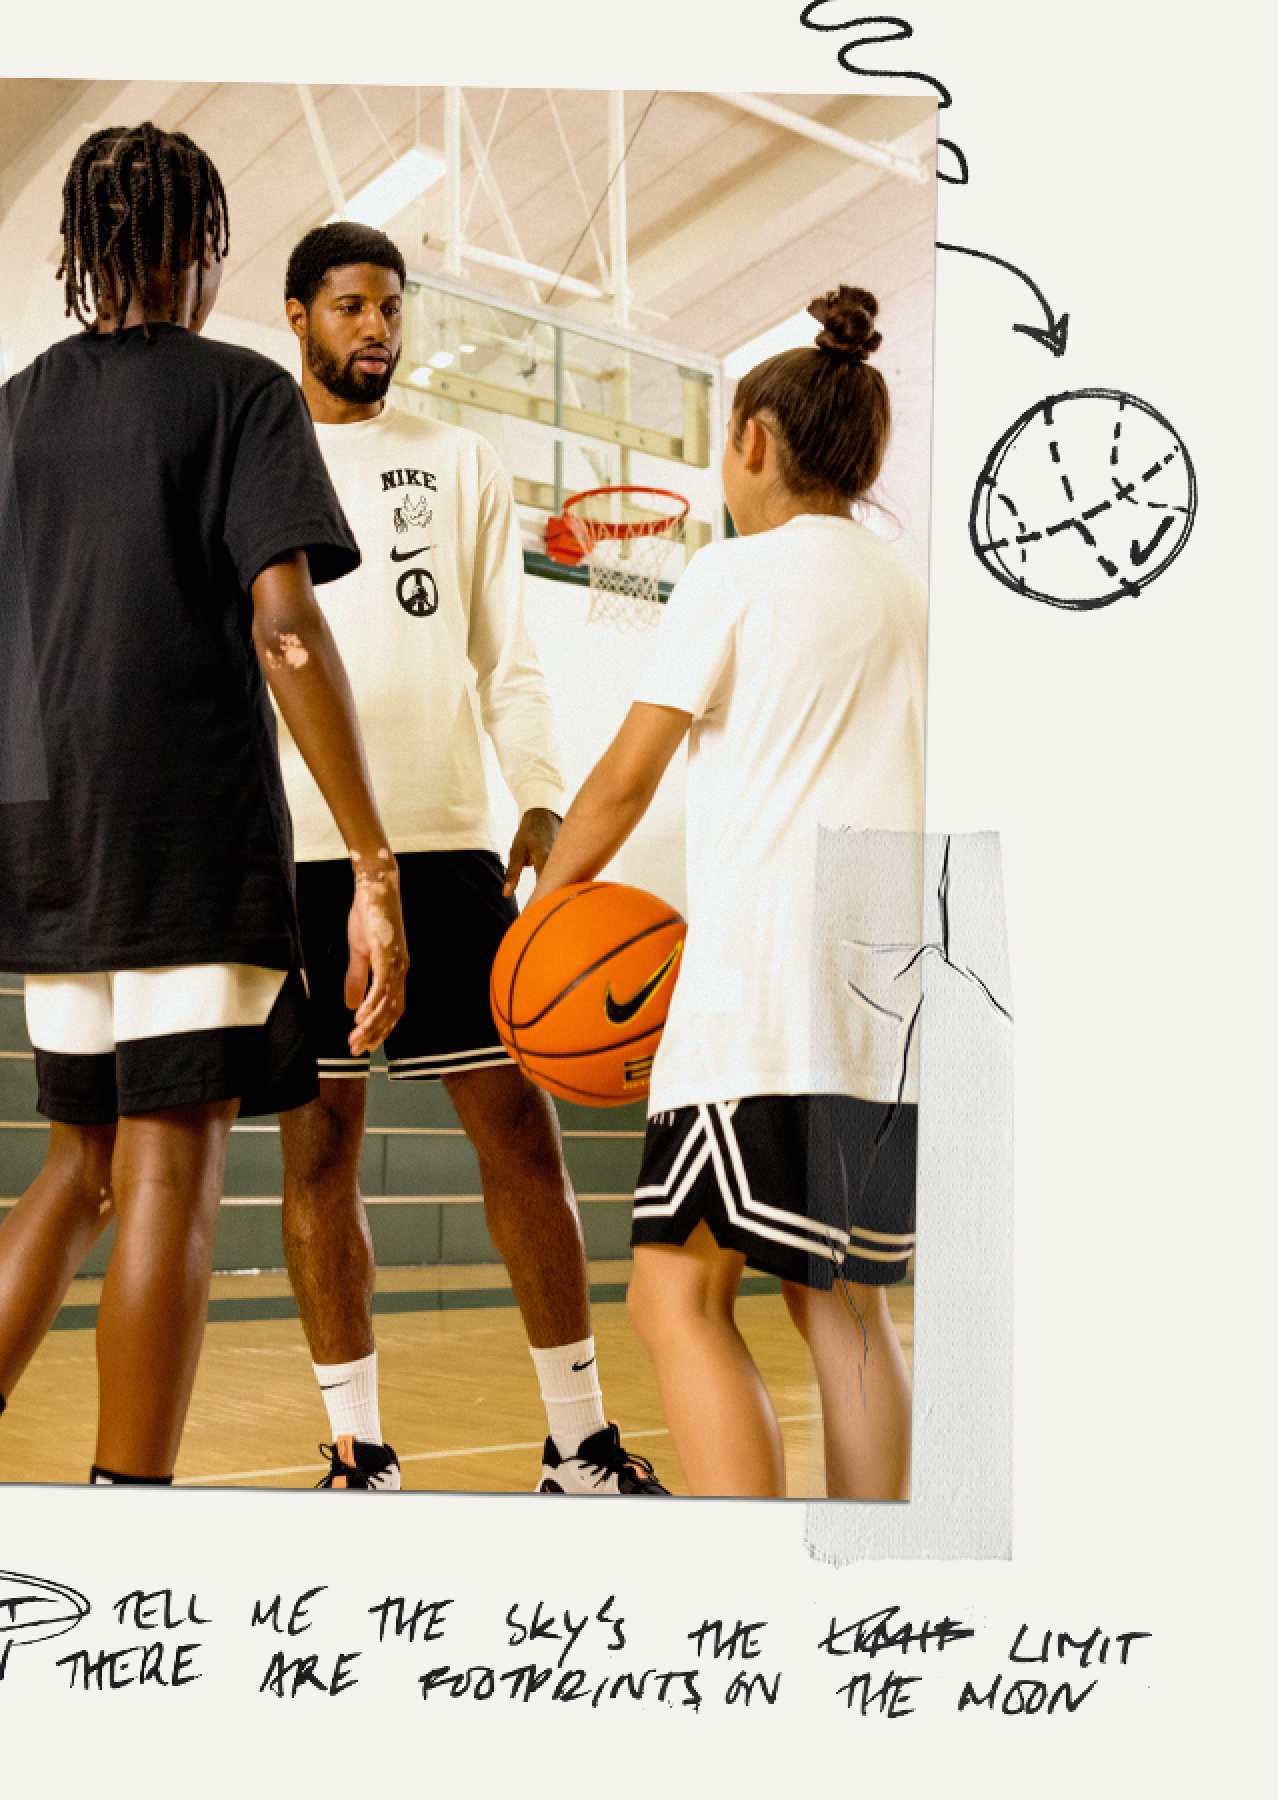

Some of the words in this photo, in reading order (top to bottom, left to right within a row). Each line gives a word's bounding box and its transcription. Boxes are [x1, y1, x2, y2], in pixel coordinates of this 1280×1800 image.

[380, 467, 437, 493] NIKE
[113, 1588, 213, 1630] TELL
[250, 1585, 330, 1637] ME
[367, 1595, 455, 1643] THE
[687, 1618, 768, 1661] THE
[1009, 1623, 1153, 1669] LIMIT
[55, 1641, 203, 1691] THERE
[259, 1651, 362, 1699] ARE
[417, 1663, 703, 1714] FOOTPRINTS
[725, 1669, 781, 1707] ON
[835, 1668, 924, 1719] THE
[957, 1672, 1100, 1716] MOON
